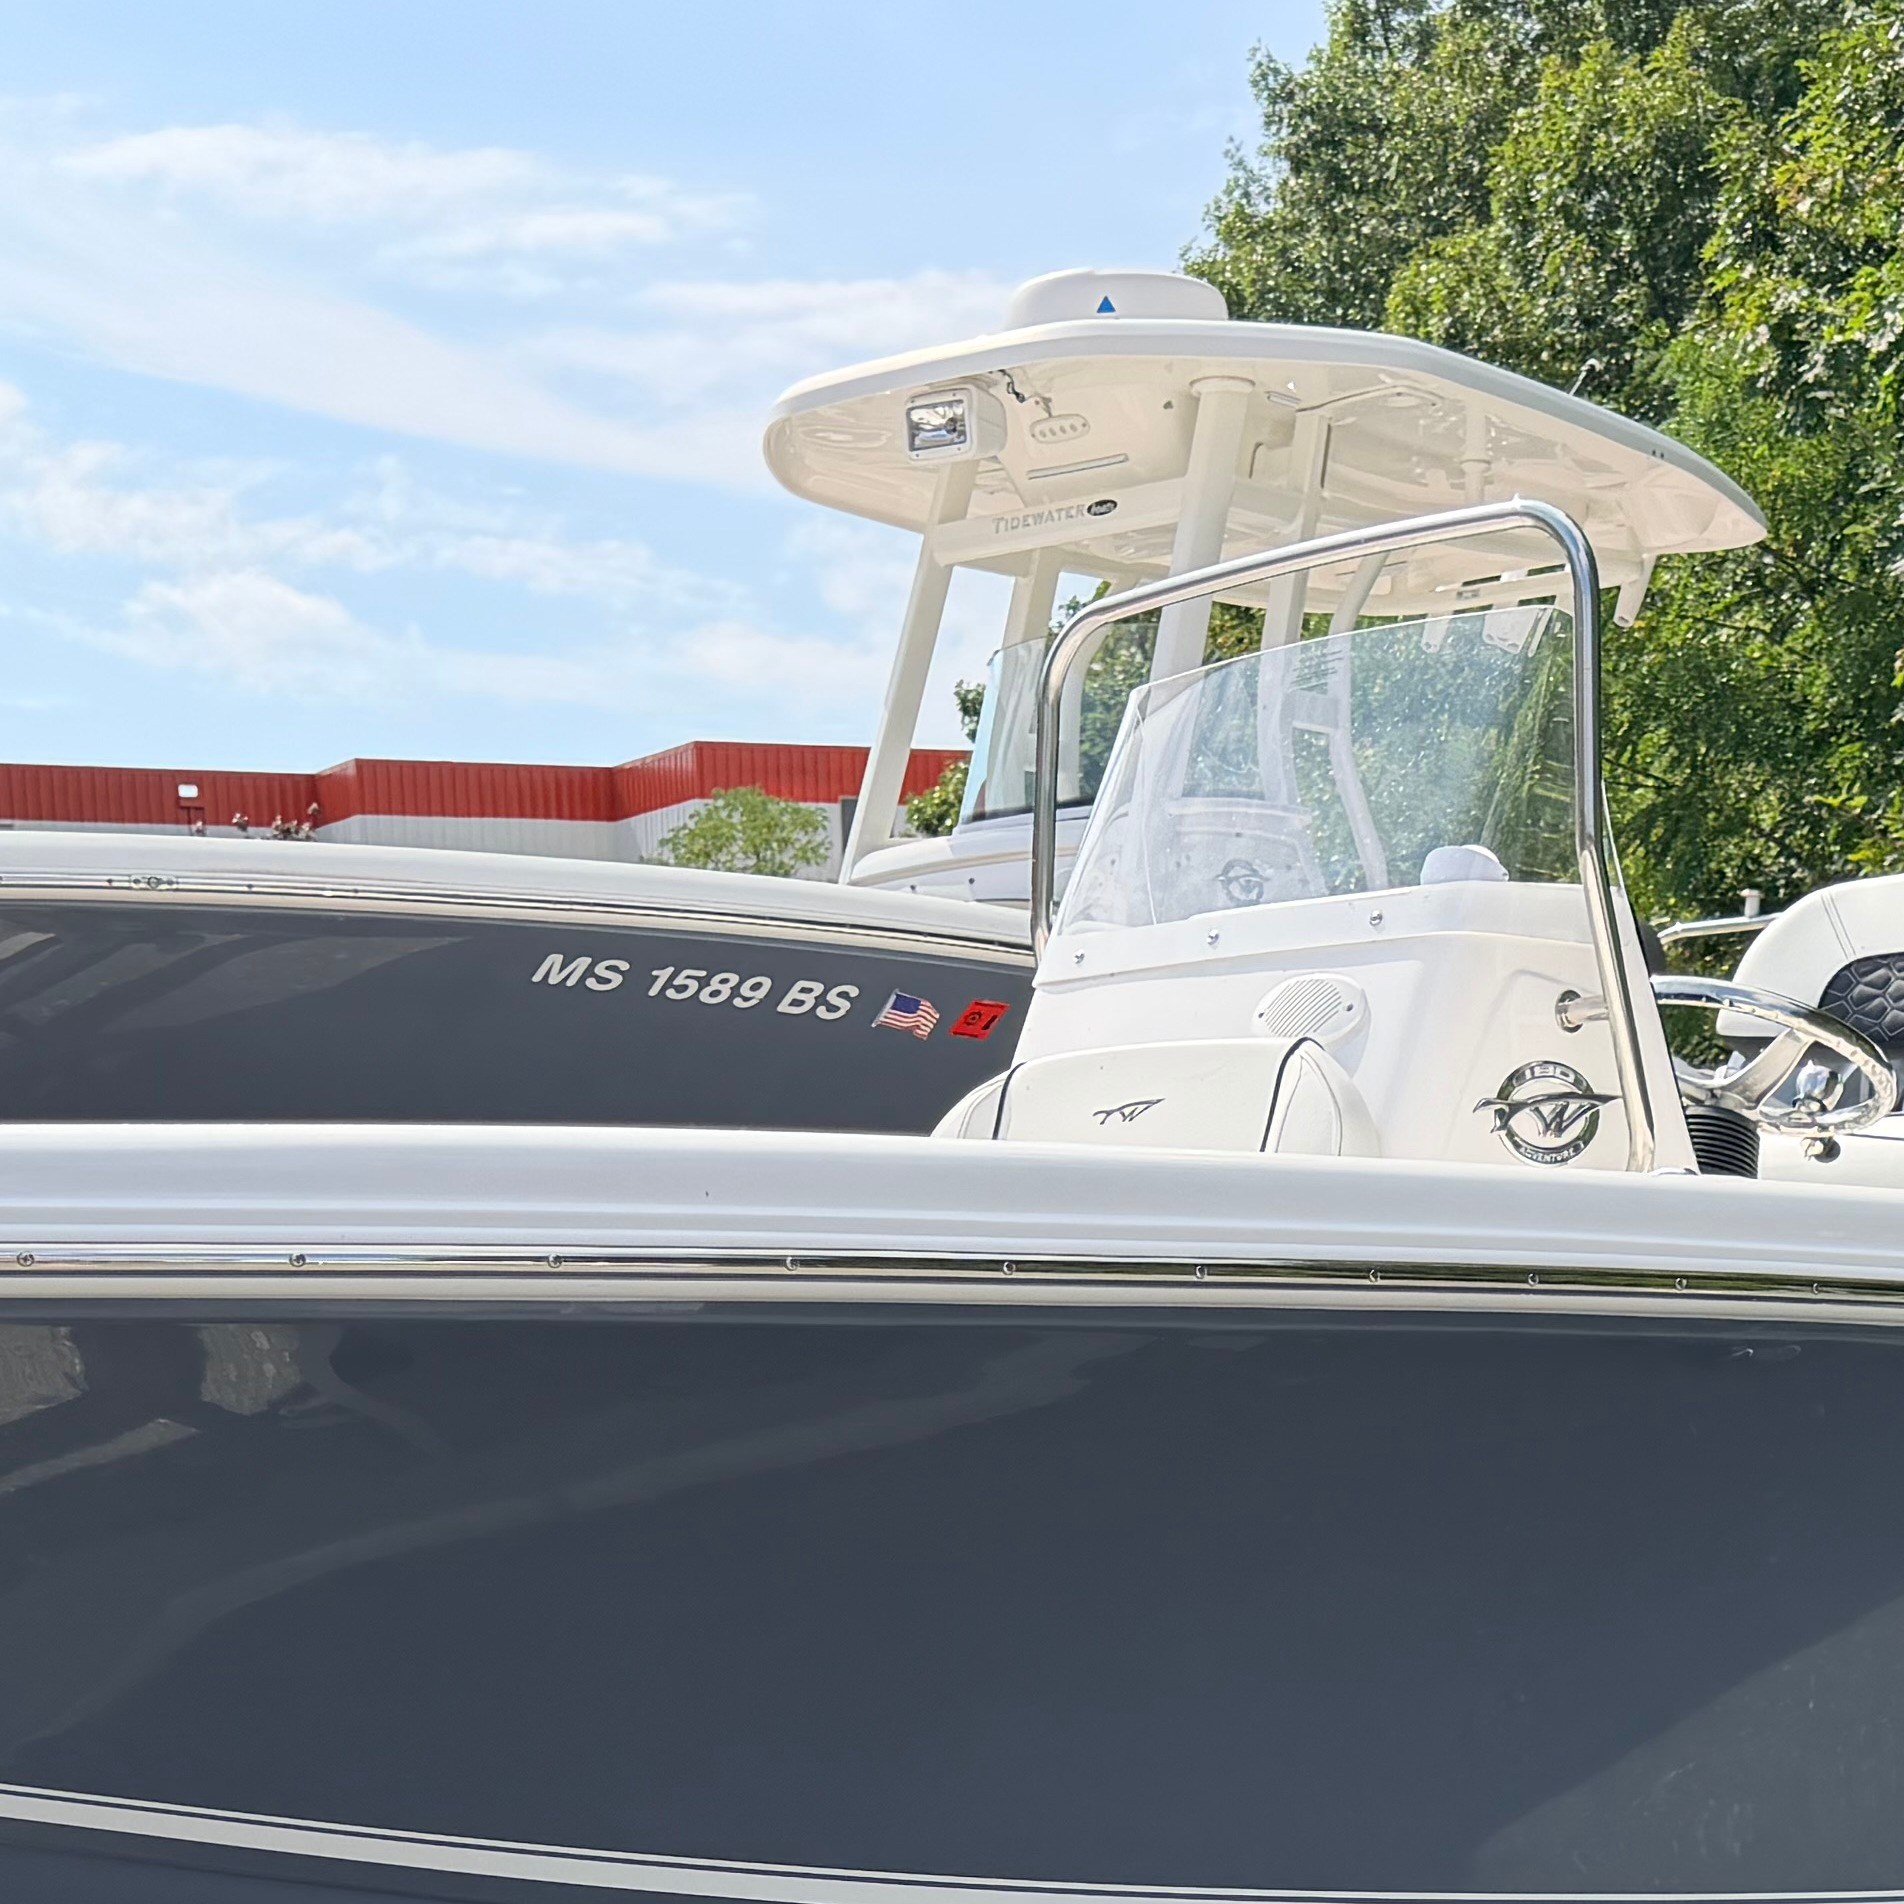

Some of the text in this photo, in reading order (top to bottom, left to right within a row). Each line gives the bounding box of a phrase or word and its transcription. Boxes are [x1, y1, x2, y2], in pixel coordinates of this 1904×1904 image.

[992, 504, 1085, 534] TIDEWATER
[531, 953, 859, 1020] MS 1589 BS
